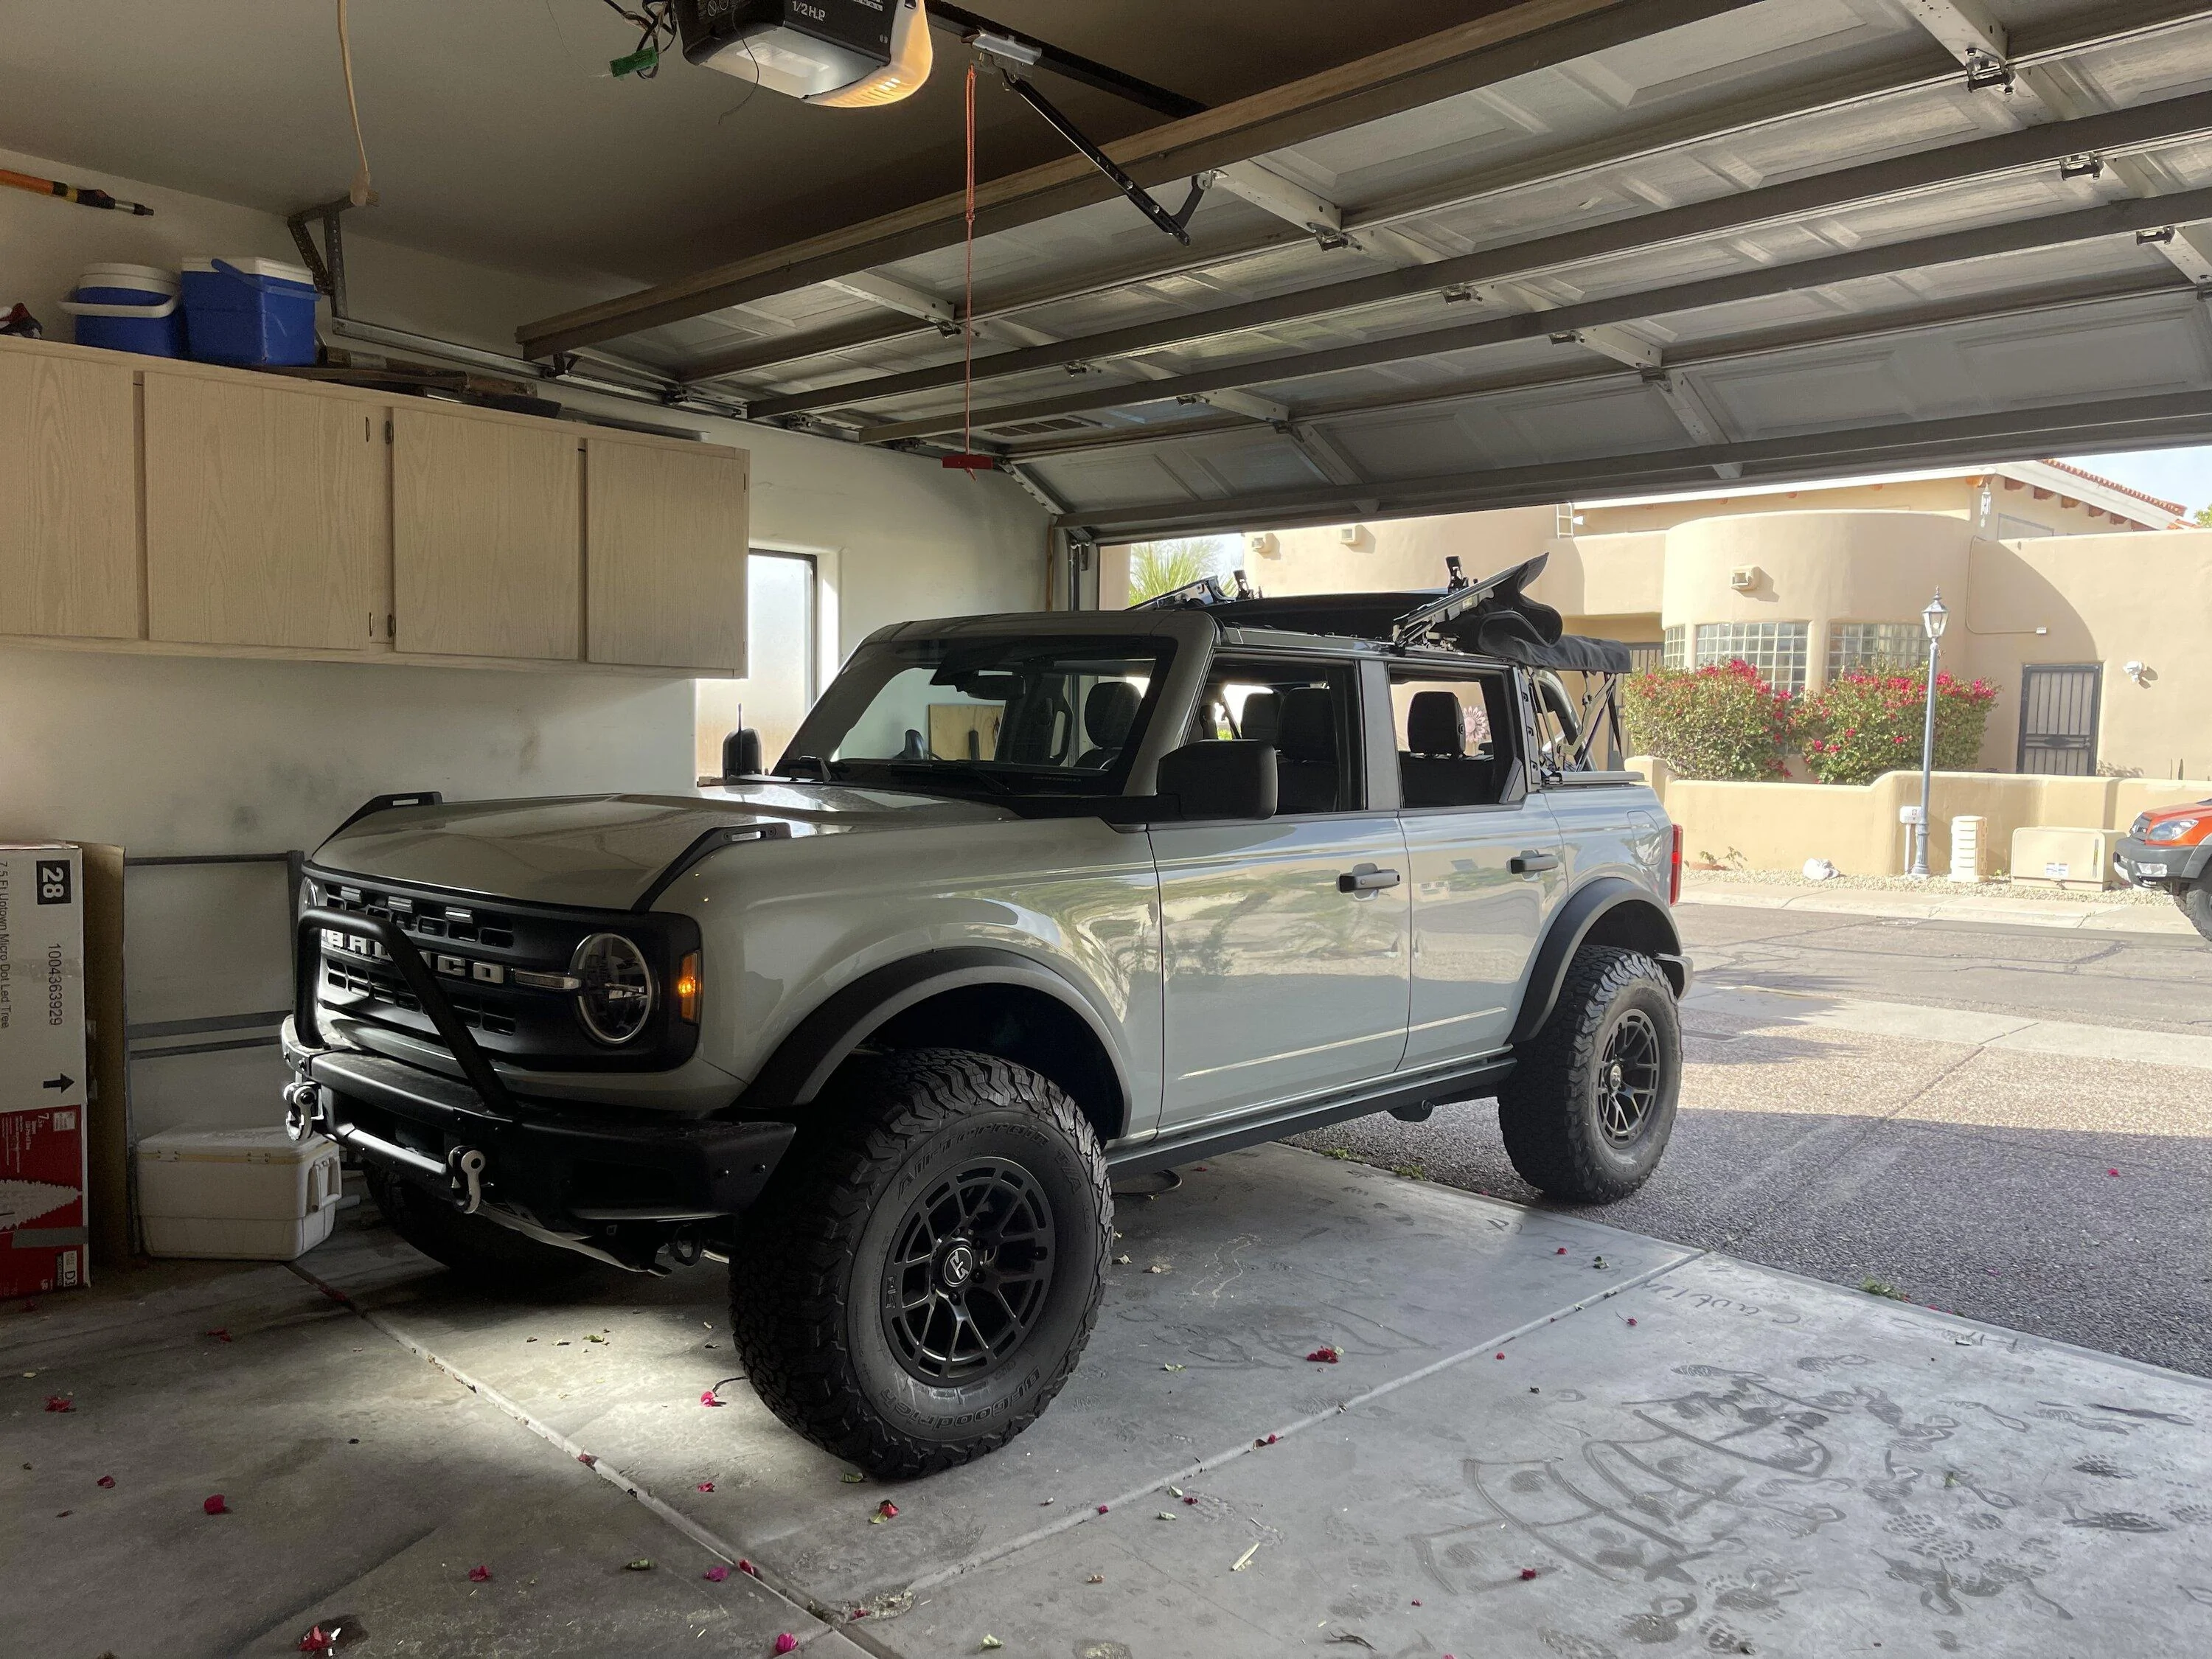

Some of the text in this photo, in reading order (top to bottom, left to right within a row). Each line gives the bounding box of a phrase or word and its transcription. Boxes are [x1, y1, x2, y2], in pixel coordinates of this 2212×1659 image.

[41, 866, 64, 899] 28
[0, 893, 10, 931] Uptown
[0, 933, 10, 961] Micro
[0, 964, 10, 982] Dot
[48, 942, 63, 1026] 1004363929
[1, 984, 11, 1003] Led
[1, 1005, 12, 1029] Tree
[880, 1366, 1040, 1433] BFGoodrich
